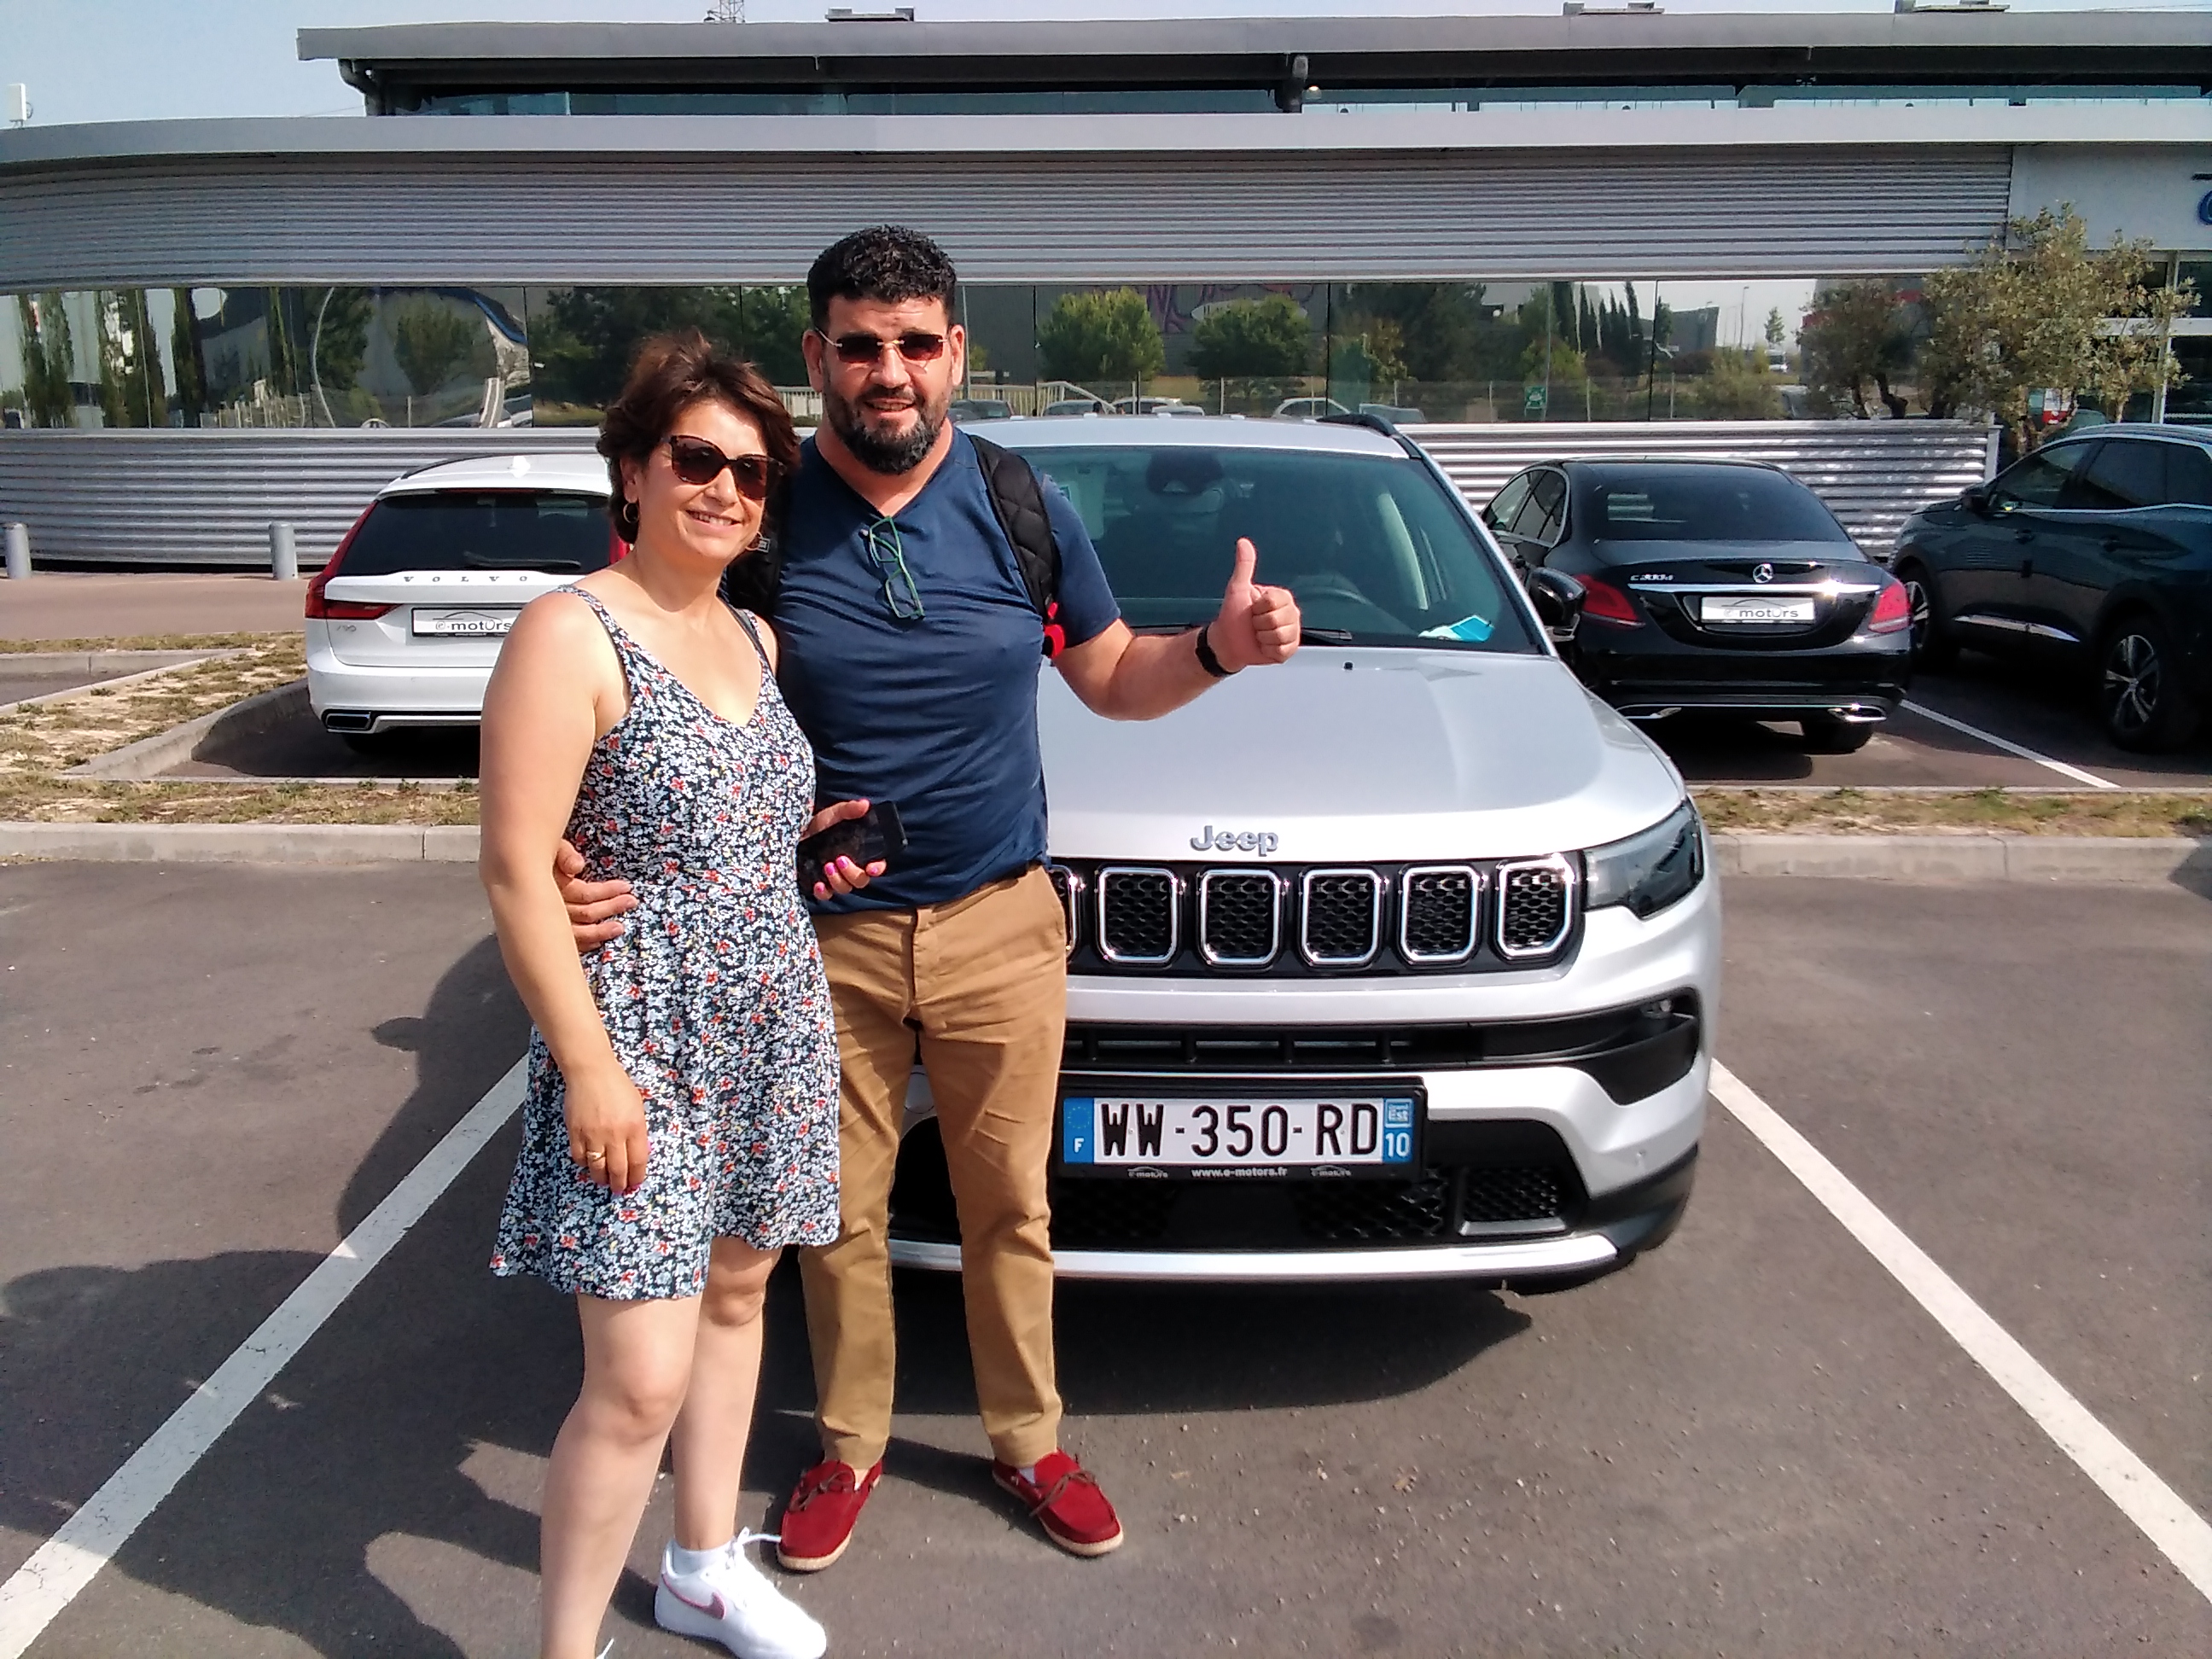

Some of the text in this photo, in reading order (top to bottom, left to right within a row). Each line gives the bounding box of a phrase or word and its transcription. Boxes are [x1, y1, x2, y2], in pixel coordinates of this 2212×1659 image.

[1190, 825, 1279, 857] Jeep
[1074, 1138, 1085, 1153] F
[1385, 1132, 1410, 1157] 10
[1191, 1167, 1288, 1178] www.e-motors.fr
